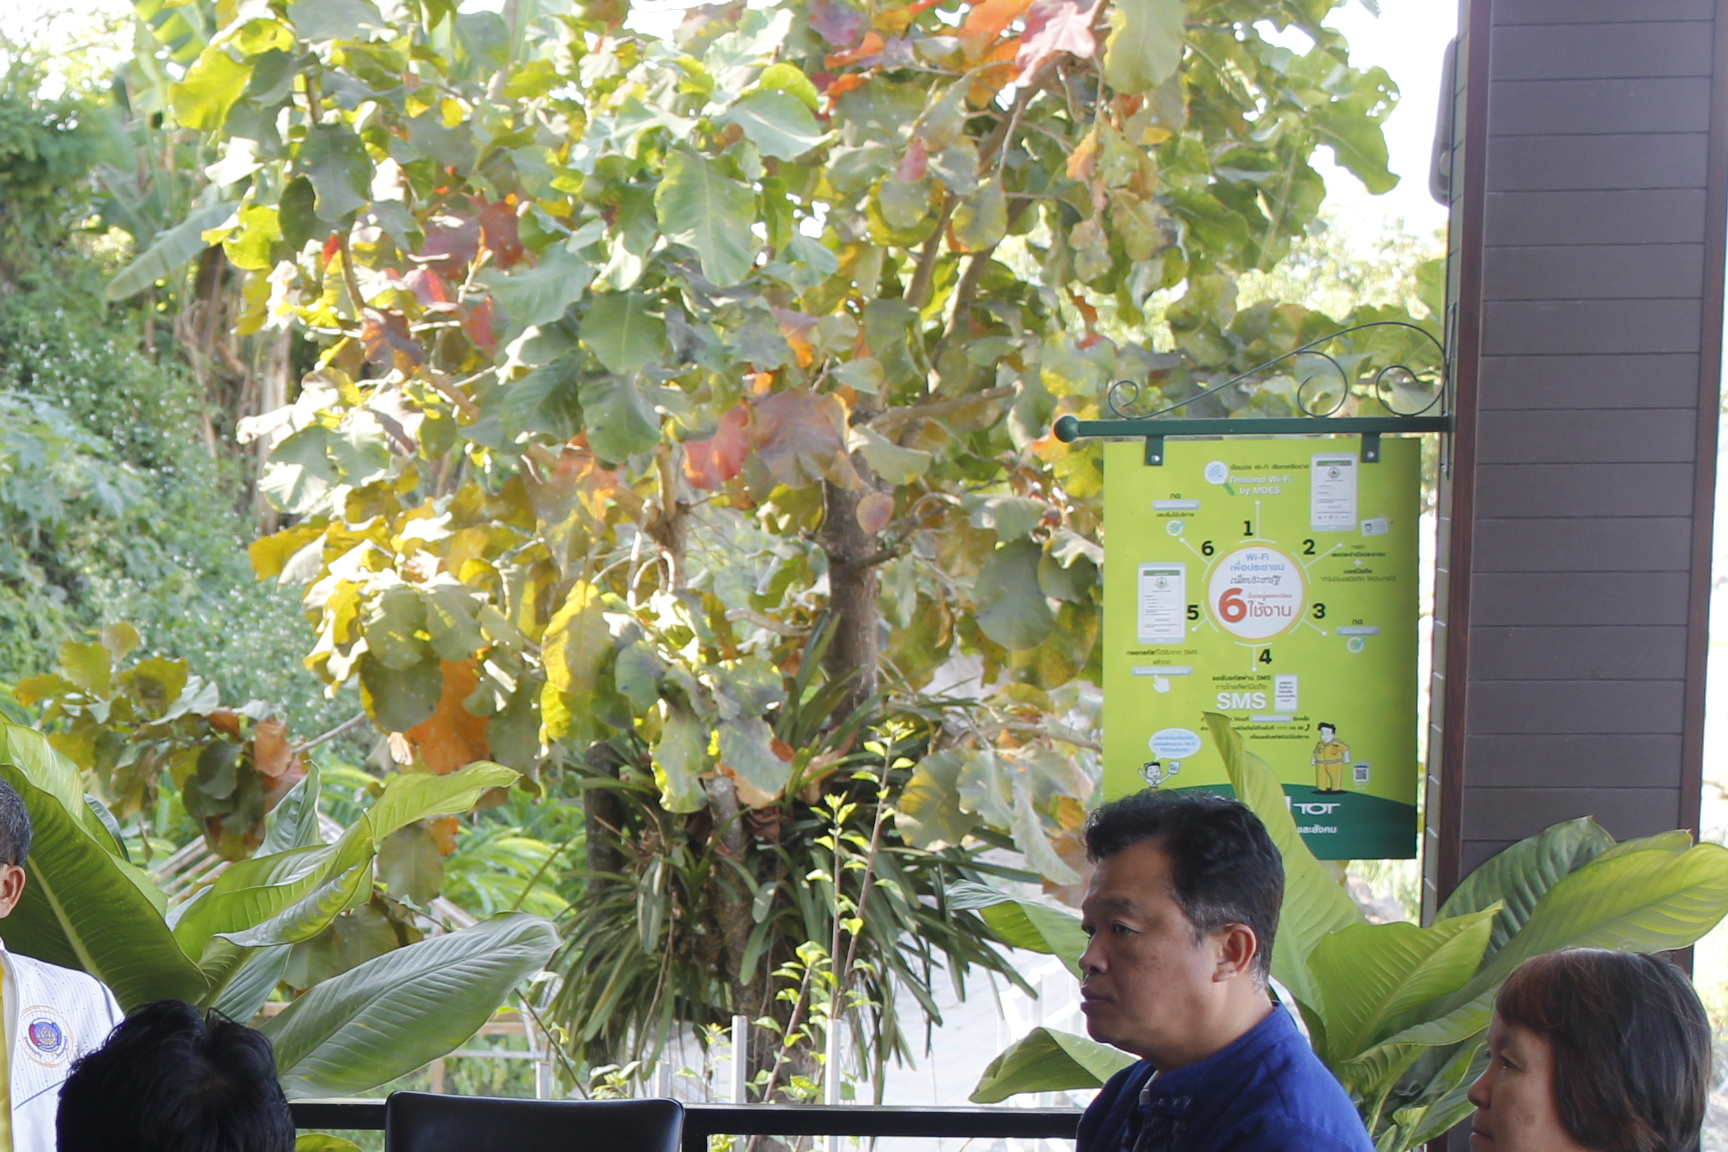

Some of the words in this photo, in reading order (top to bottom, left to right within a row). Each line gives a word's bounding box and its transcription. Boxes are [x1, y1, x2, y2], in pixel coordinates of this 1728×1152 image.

[1229, 475, 1266, 484] Thailand
[1268, 475, 1292, 483] Wi-Fi
[1239, 487, 1250, 496] by
[1253, 486, 1281, 495] MDES
[1243, 520, 1253, 536] 1
[1201, 540, 1215, 556] 6
[1302, 538, 1316, 555] 2
[1245, 553, 1269, 561] Wi-Fi
[1230, 560, 1285, 572] เพื่อประชาชน
[1186, 604, 1199, 620] 5
[1218, 587, 1247, 623] 6
[1247, 600, 1292, 617] ใช้งาน
[1312, 602, 1326, 619] 3
[1258, 648, 1272, 664] 4
[1216, 691, 1267, 710] SMS
[1292, 802, 1341, 815] TOT
